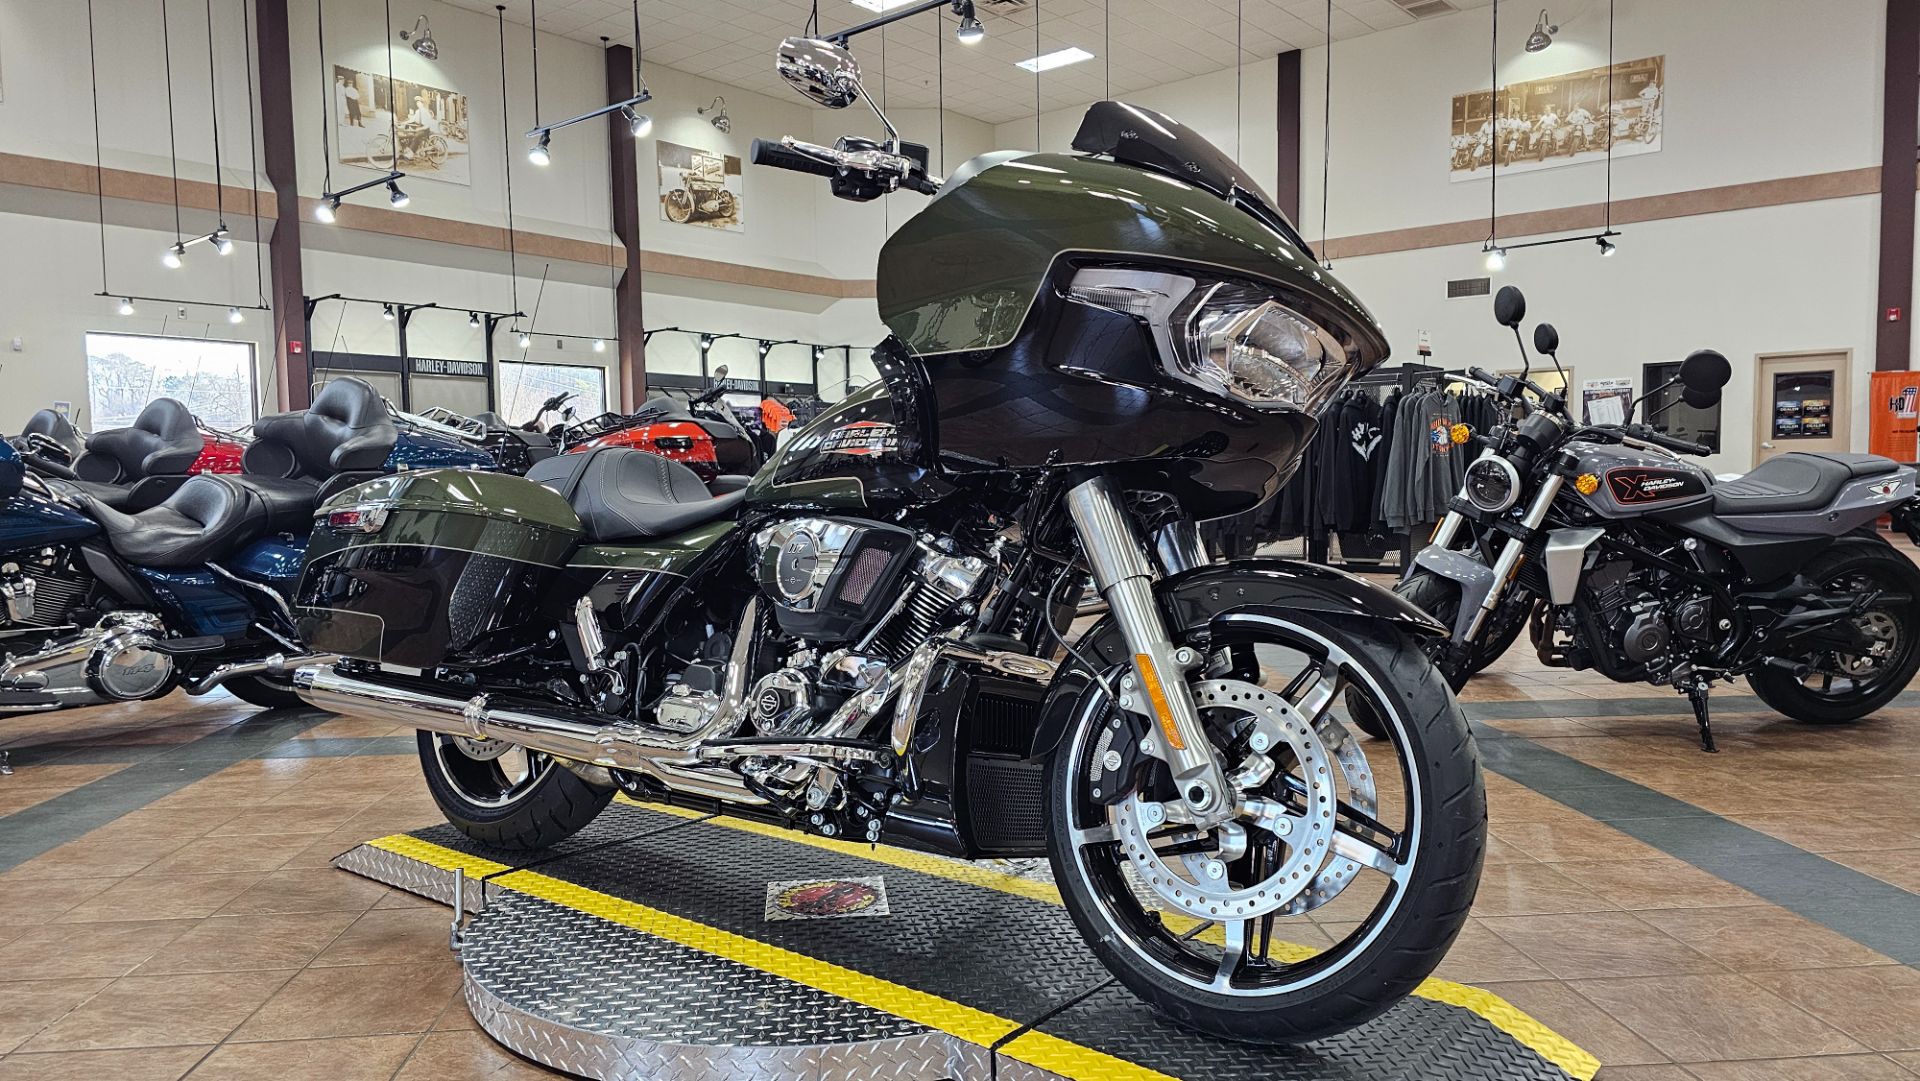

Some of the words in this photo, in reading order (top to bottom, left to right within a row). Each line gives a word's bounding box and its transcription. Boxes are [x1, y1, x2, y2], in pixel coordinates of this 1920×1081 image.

[415, 359, 483, 375] HARLEY-DAVIDSON
[1643, 481, 1684, 491] DAVIDSON
[787, 541, 809, 554] 117
